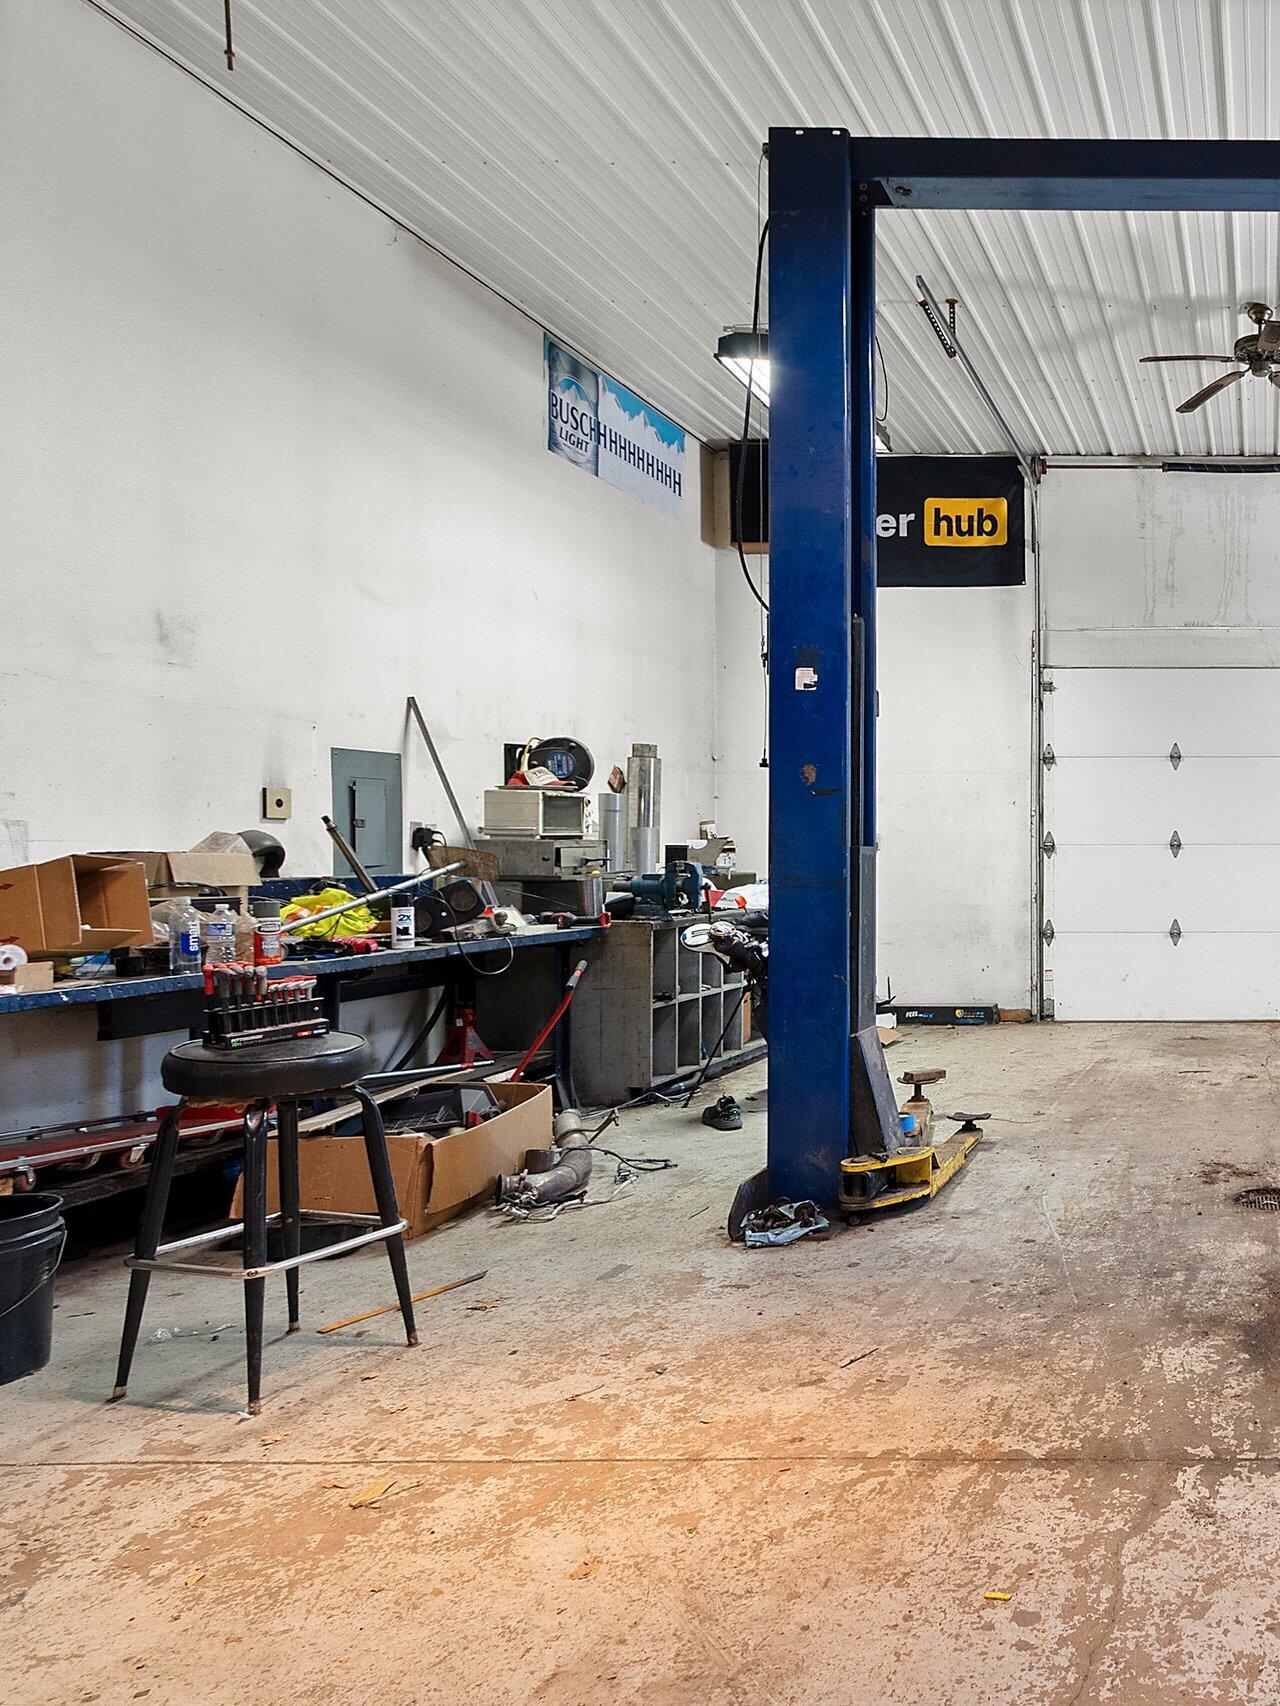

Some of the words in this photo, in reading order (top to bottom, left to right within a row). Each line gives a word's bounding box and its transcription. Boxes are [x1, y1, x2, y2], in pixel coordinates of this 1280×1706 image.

[559, 427, 589, 453] LIGHT
[877, 510, 915, 538] er
[933, 507, 998, 537] hub
[189, 920, 198, 951] smart
